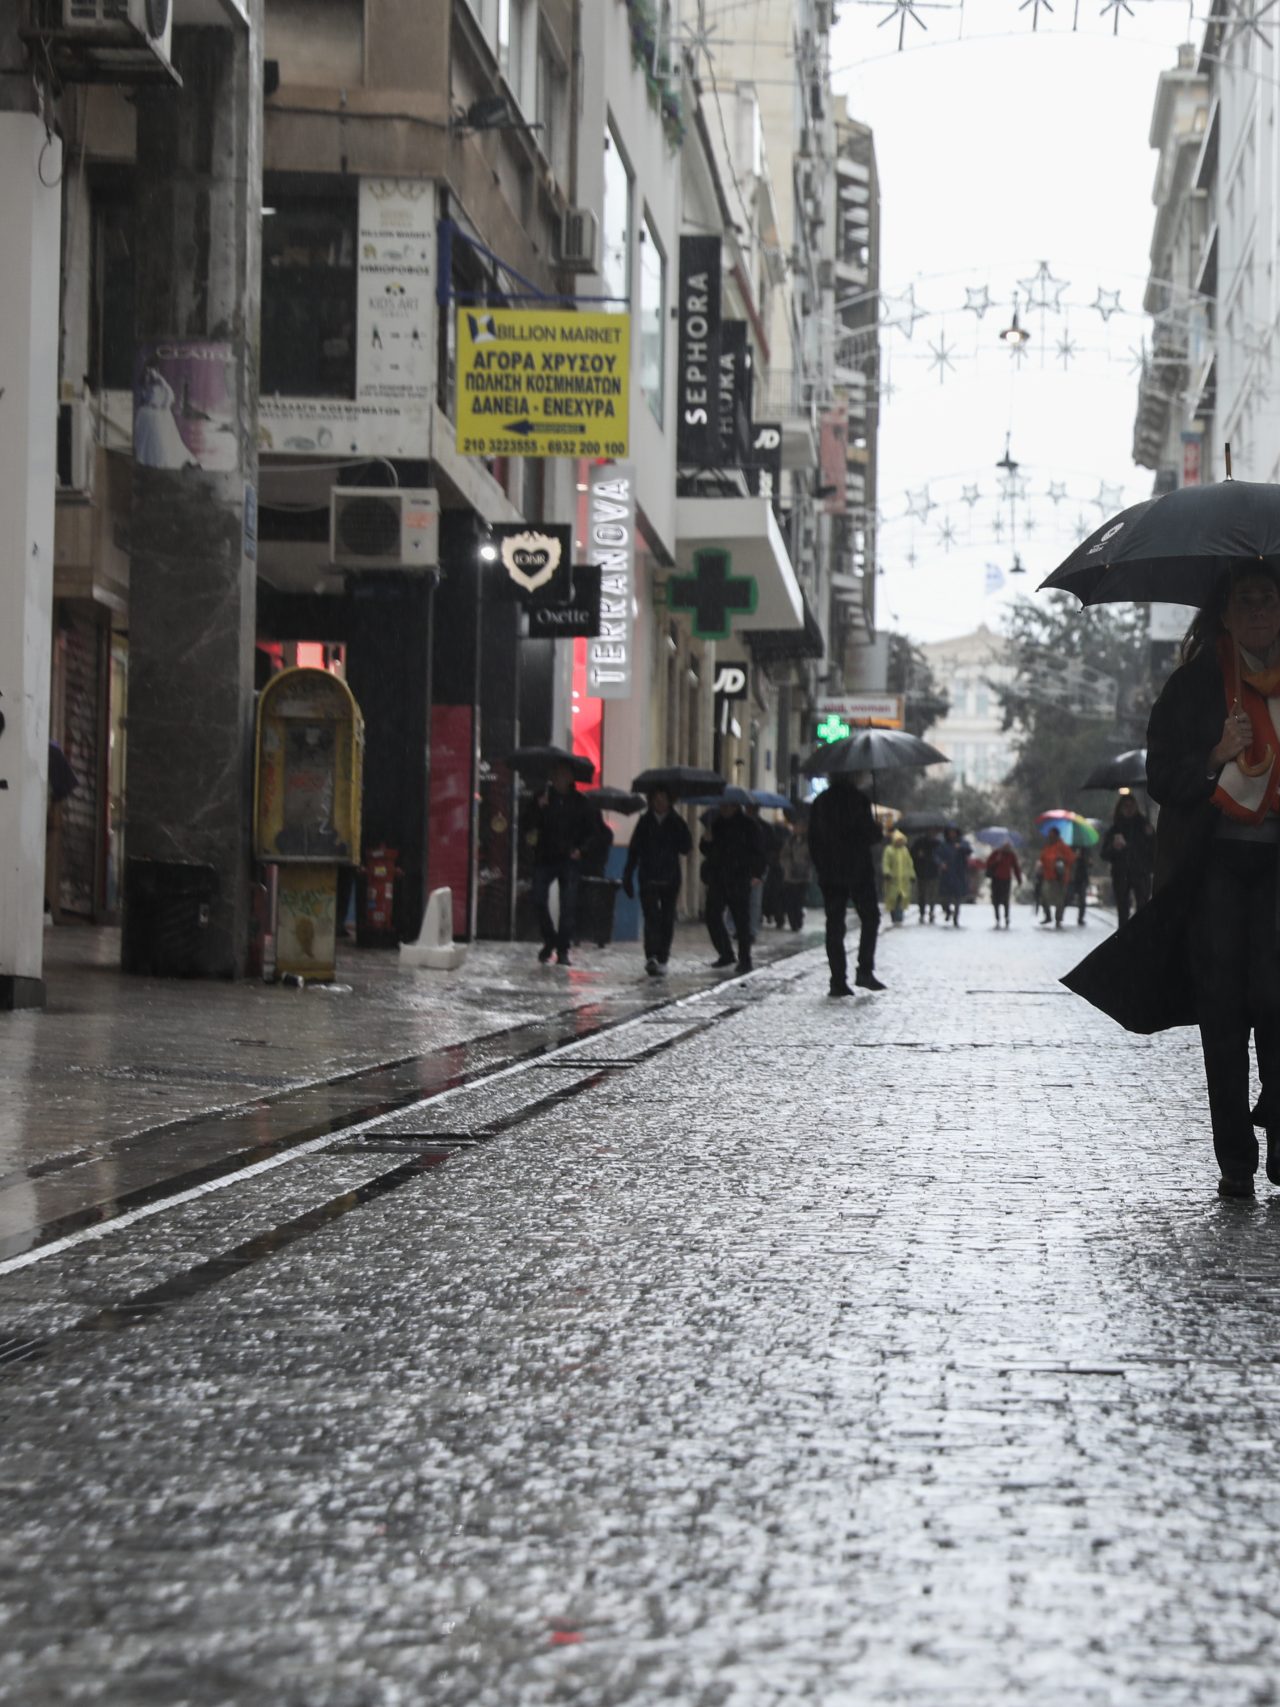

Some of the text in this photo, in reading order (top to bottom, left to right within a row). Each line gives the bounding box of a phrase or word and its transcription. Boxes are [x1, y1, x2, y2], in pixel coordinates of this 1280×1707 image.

[496, 324, 622, 344] BILLION MARKET
[685, 272, 709, 425] SEPHORA
[473, 351, 616, 374] ΑΓΟΡΑ ΧΡΥΣΟΥ
[465, 372, 621, 396] ΠΩΛΗΣΗ ΚΟΣΜΗΜΑΤΩΝ
[472, 396, 530, 416] ΔΑΝΕΙΑ
[543, 398, 615, 418] ΕΝΕΧΥΡΑ
[579, 441, 601, 454] 200
[604, 442, 625, 455] 100
[589, 478, 630, 688] TERRANOVA
[536, 607, 589, 625] Oxette
[712, 668, 746, 693] JD
